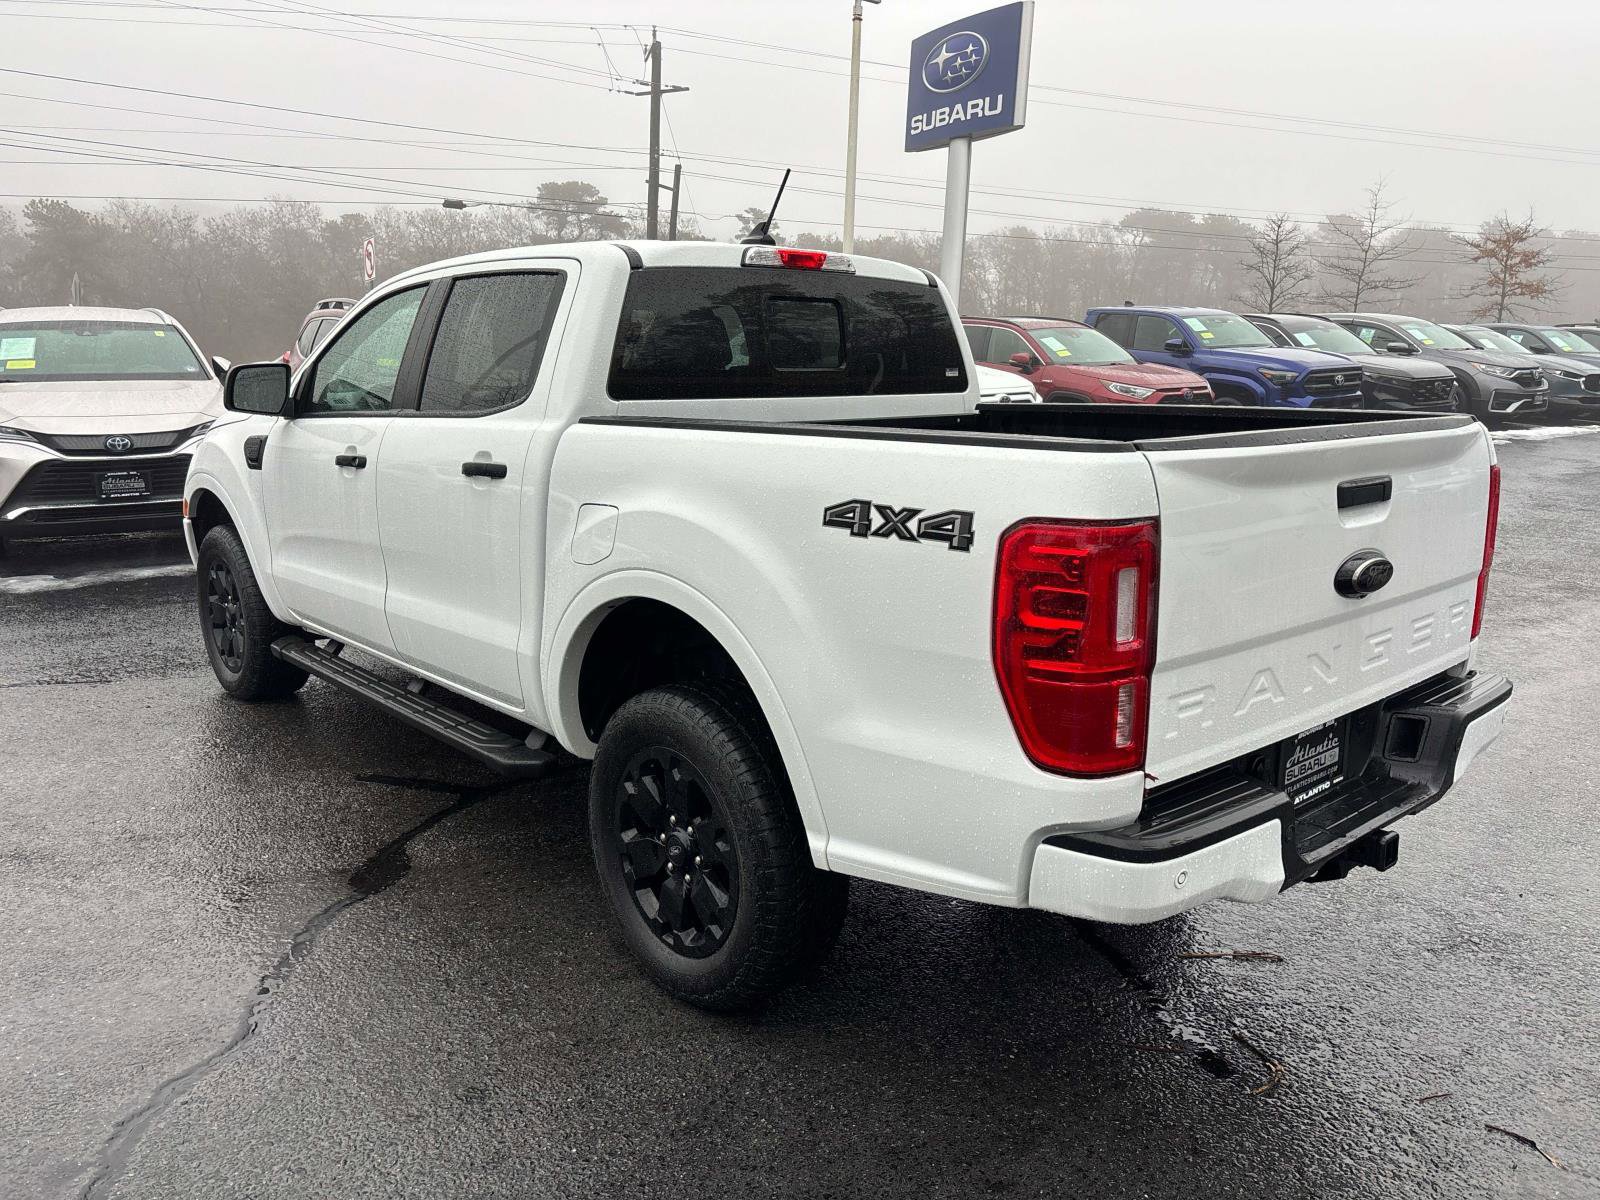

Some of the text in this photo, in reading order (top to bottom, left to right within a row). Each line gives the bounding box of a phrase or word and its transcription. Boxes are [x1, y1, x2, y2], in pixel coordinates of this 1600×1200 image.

[910, 94, 1004, 136] SUBARU
[1286, 732, 1340, 768] Atlantic
[1286, 754, 1327, 781] SUBARU
[1293, 781, 1331, 805] ATLANTIC
